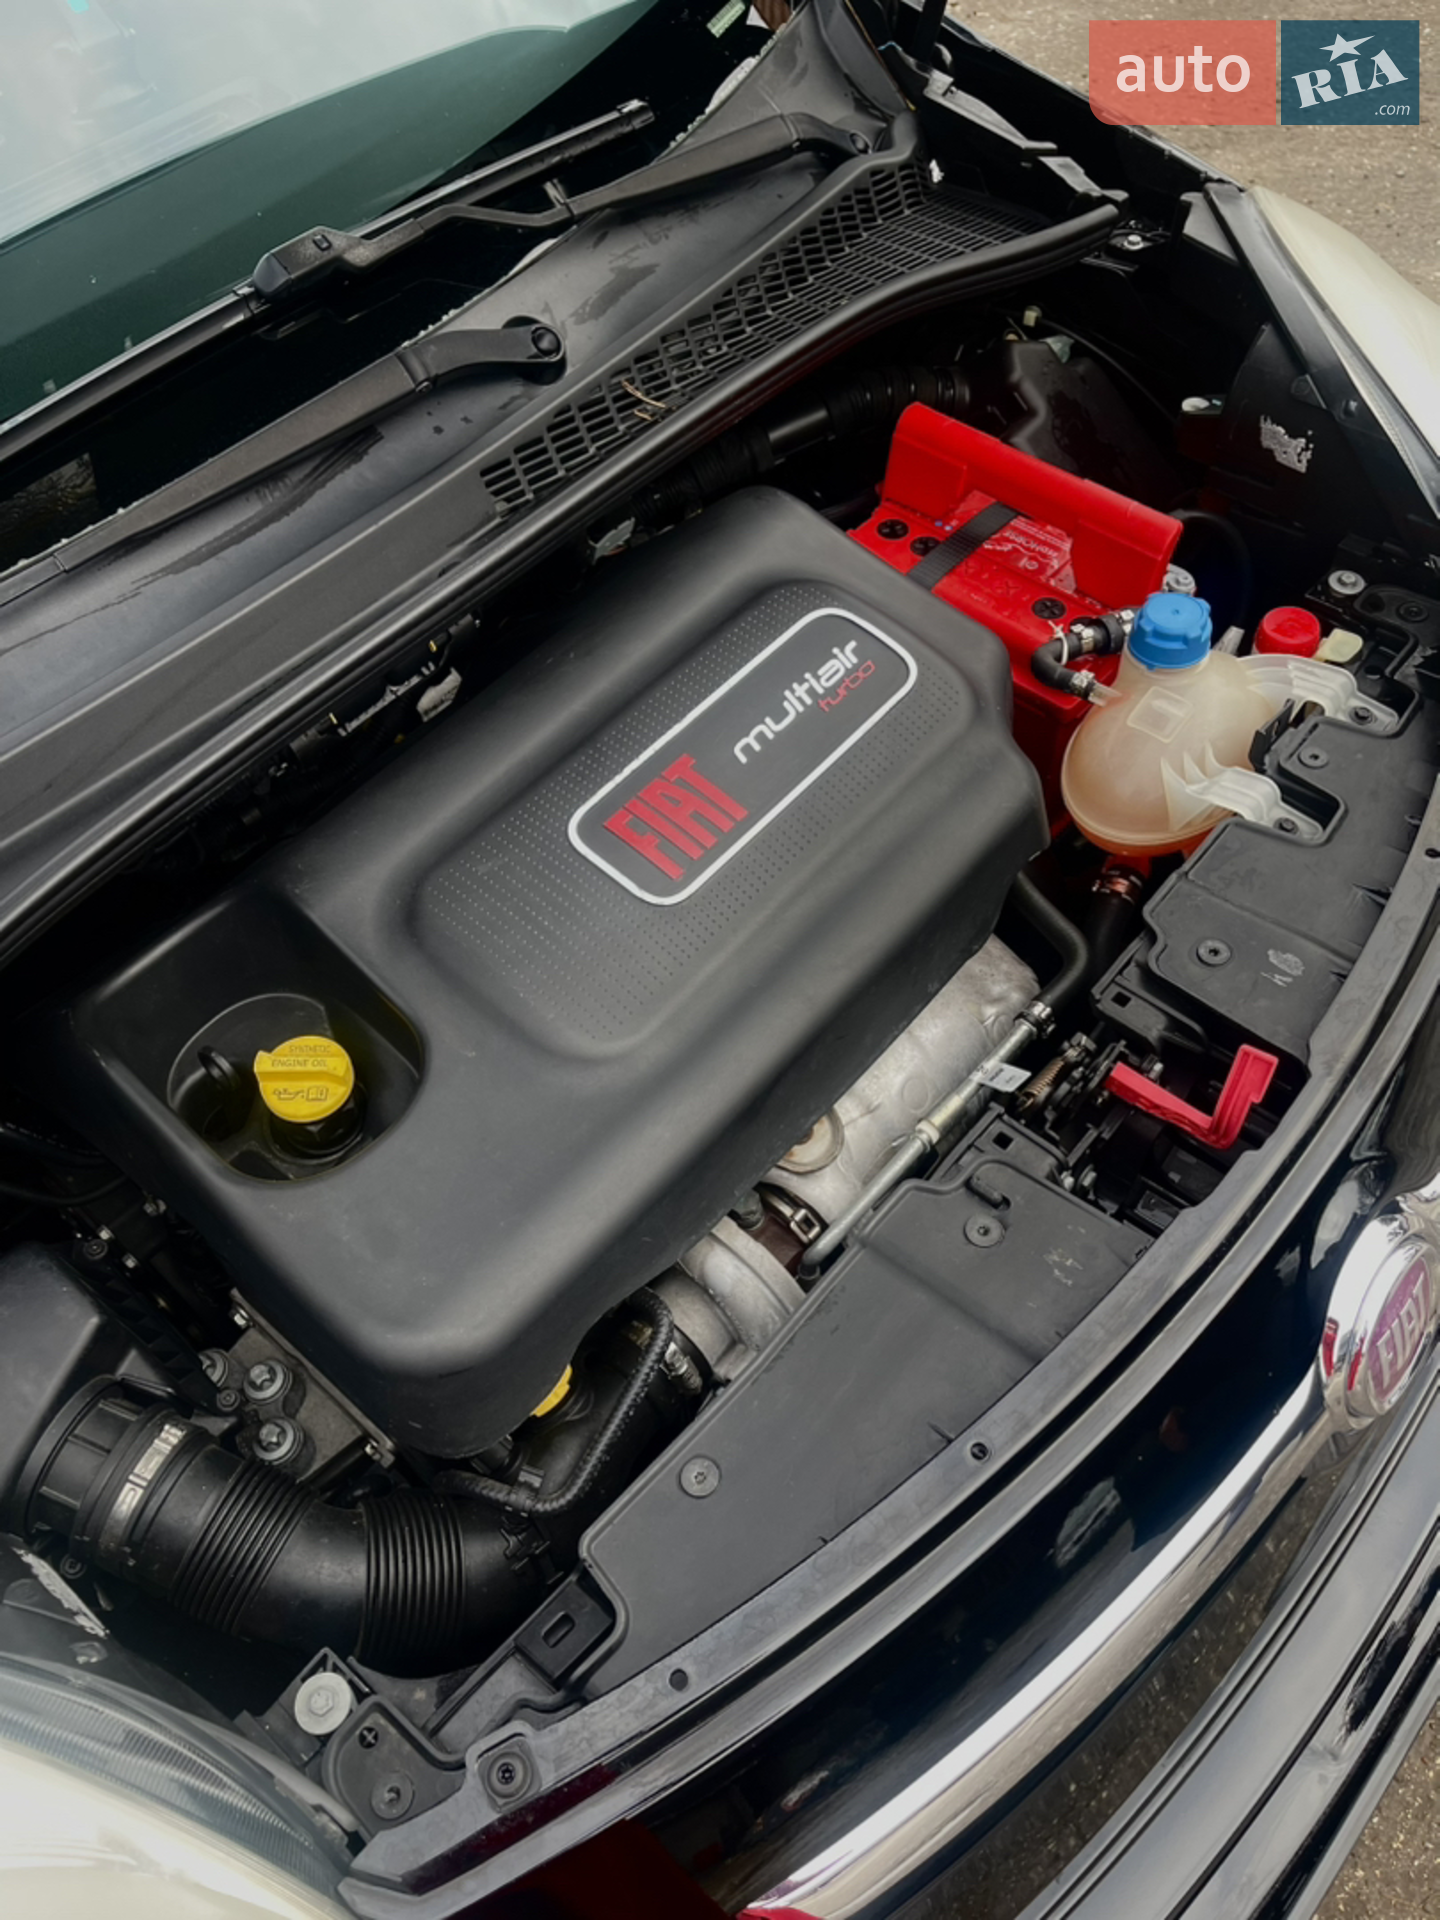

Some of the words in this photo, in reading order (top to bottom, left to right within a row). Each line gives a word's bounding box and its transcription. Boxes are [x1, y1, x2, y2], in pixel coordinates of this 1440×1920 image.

[733, 640, 858, 764] multiair
[818, 660, 876, 712] turbo
[603, 753, 749, 880] FIAT
[271, 1058, 309, 1068] ENGINE
[311, 1058, 327, 1068] OIL
[1376, 1271, 1427, 1389] FIAT
